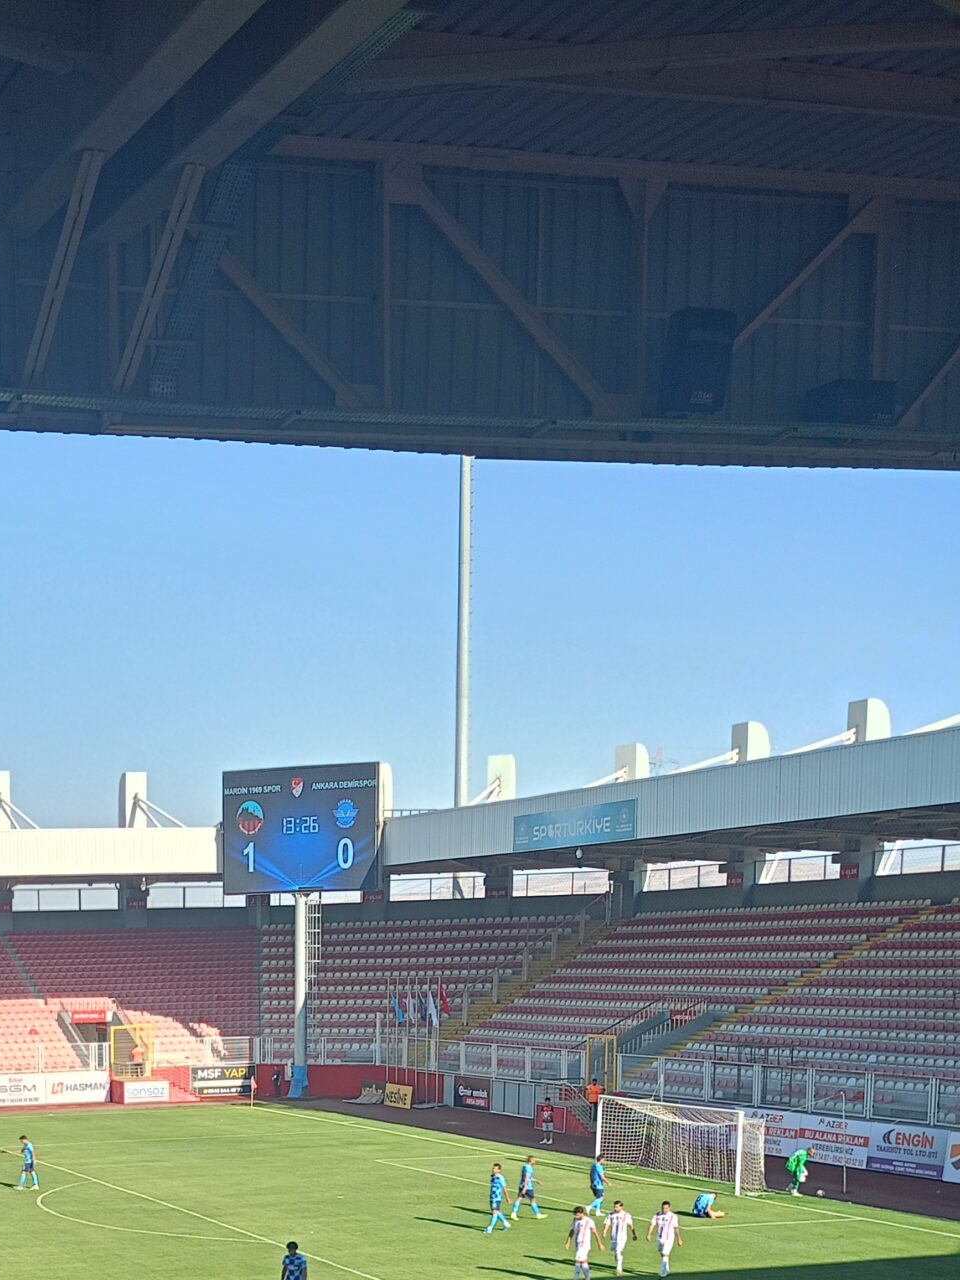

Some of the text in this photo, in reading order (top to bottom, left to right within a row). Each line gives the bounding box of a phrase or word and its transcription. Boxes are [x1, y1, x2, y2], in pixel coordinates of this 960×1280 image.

[263, 785, 281, 793] SPOR
[312, 781, 339, 790] ANKARA
[283, 816, 319, 835] 13:26
[243, 842, 255, 873] 1
[337, 837, 354, 870] 0
[198, 1068, 222, 1080] MSF
[65, 1081, 106, 1092] HASMAN
[385, 1087, 408, 1105] NESİNE
[768, 1127, 795, 1138] REKLAM
[804, 1129, 814, 1139] BU
[814, 1131, 837, 1143] ALANA
[895, 1131, 935, 1150] ENGİN
